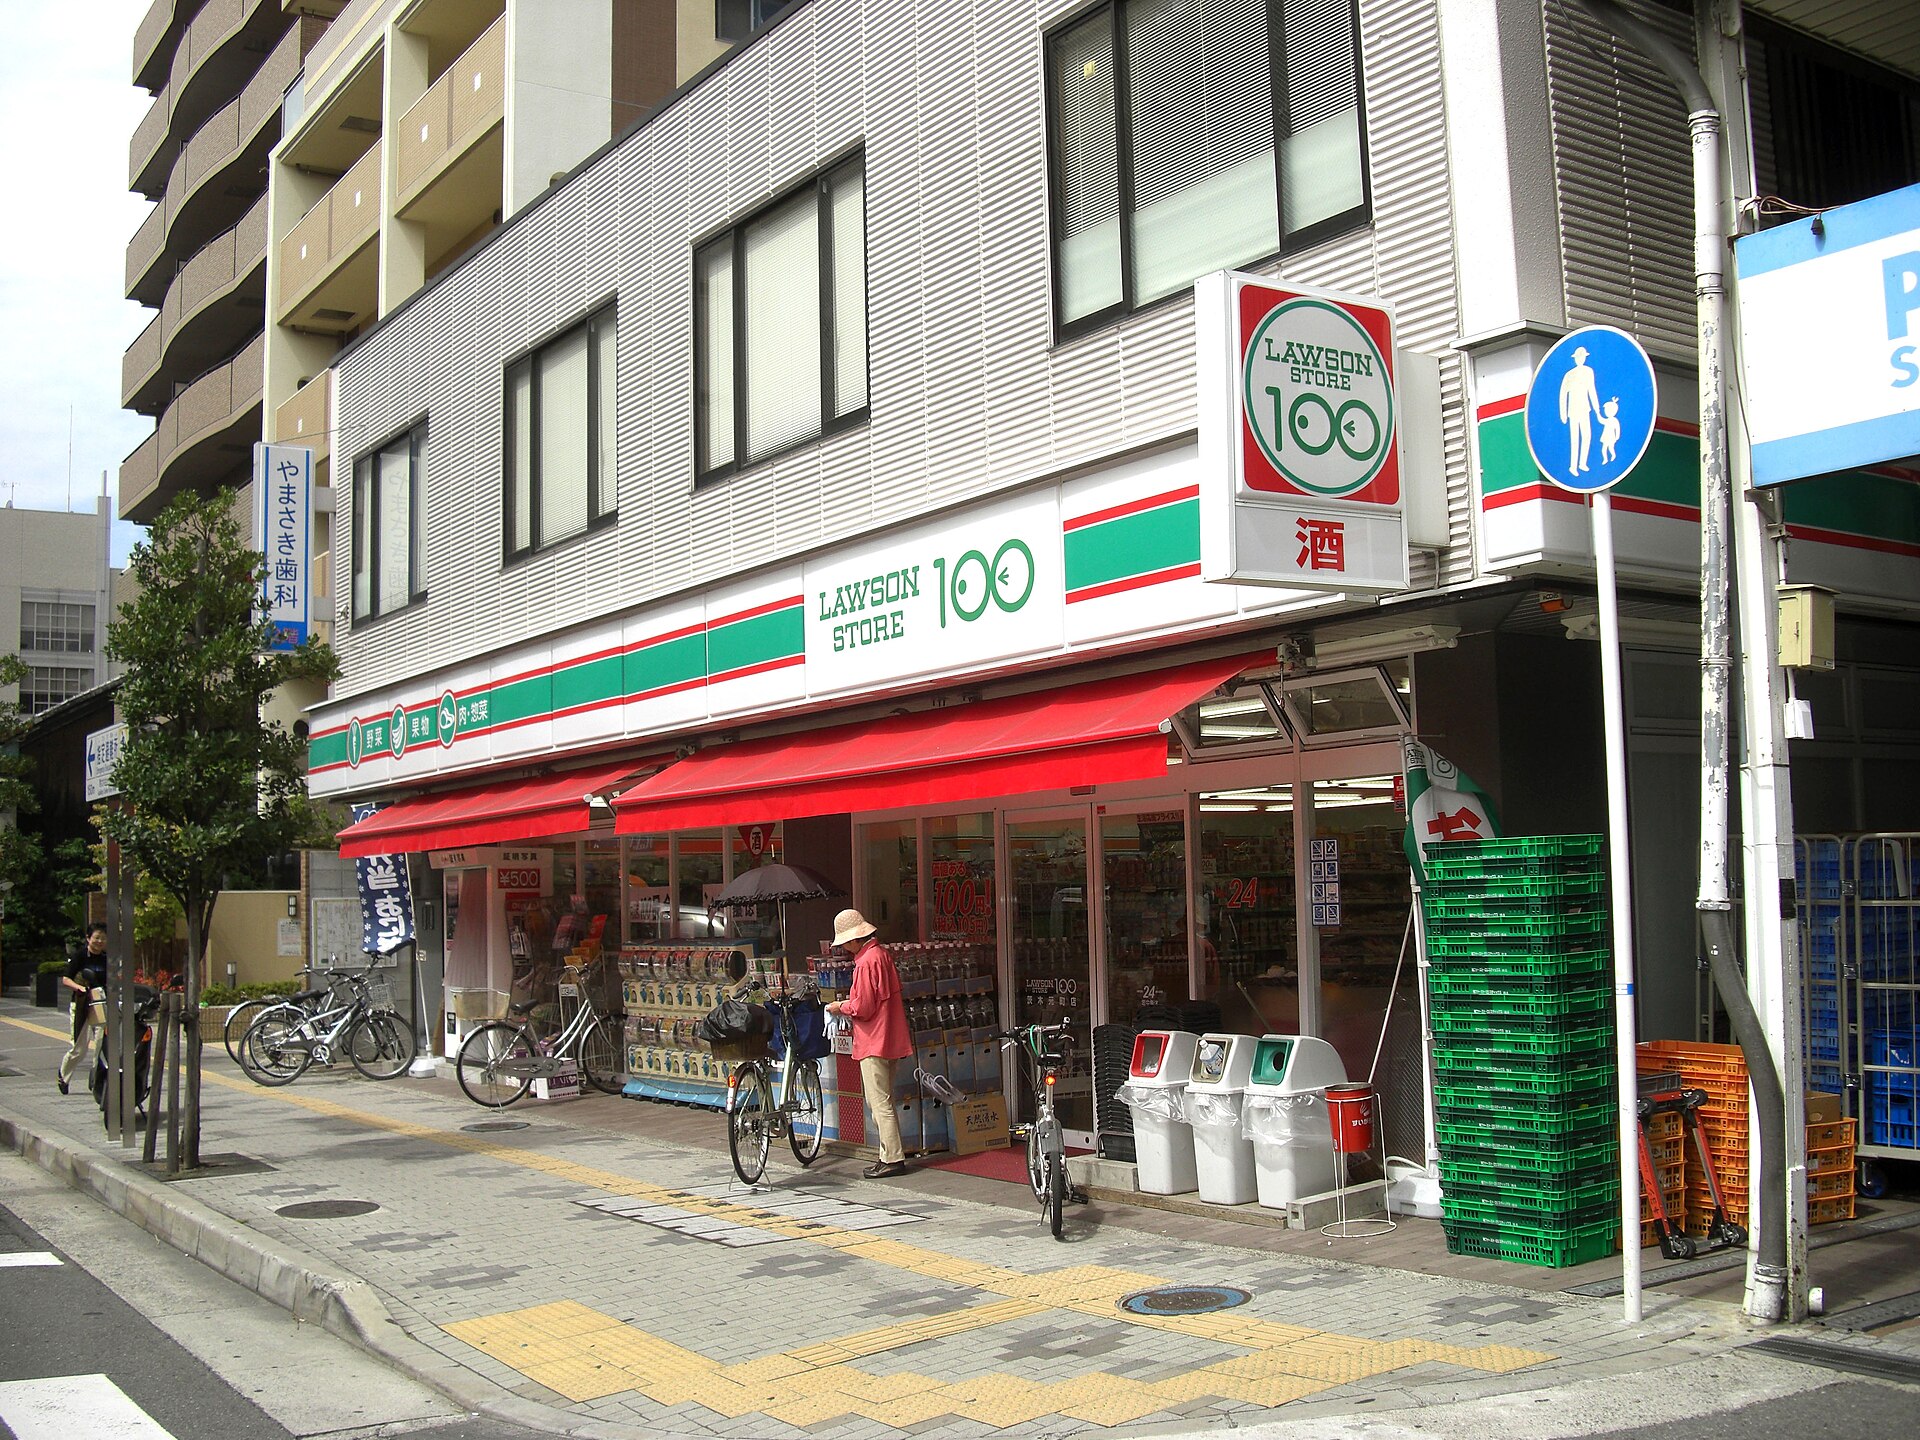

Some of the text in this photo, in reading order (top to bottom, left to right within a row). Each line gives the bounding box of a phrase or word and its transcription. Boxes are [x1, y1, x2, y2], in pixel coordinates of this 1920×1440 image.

[1265, 338, 1373, 377] LAWSON
[1290, 366, 1351, 391] STORE
[1265, 385, 1381, 462] 100
[274, 460, 299, 609] やまさき歯科
[1295, 517, 1345, 573] 酒
[819, 538, 1035, 628] LAWSON 100
[833, 610, 904, 652] STORE
[366, 727, 383, 749] 野菜
[411, 715, 430, 738] 果物
[751, 831, 762, 850] 酒
[503, 852, 538, 861] 証明写真
[499, 870, 539, 887] ¥500
[1227, 876, 1258, 909] 24
[1026, 978, 1077, 994] LAWSON 100
[1142, 985, 1156, 999] 24
